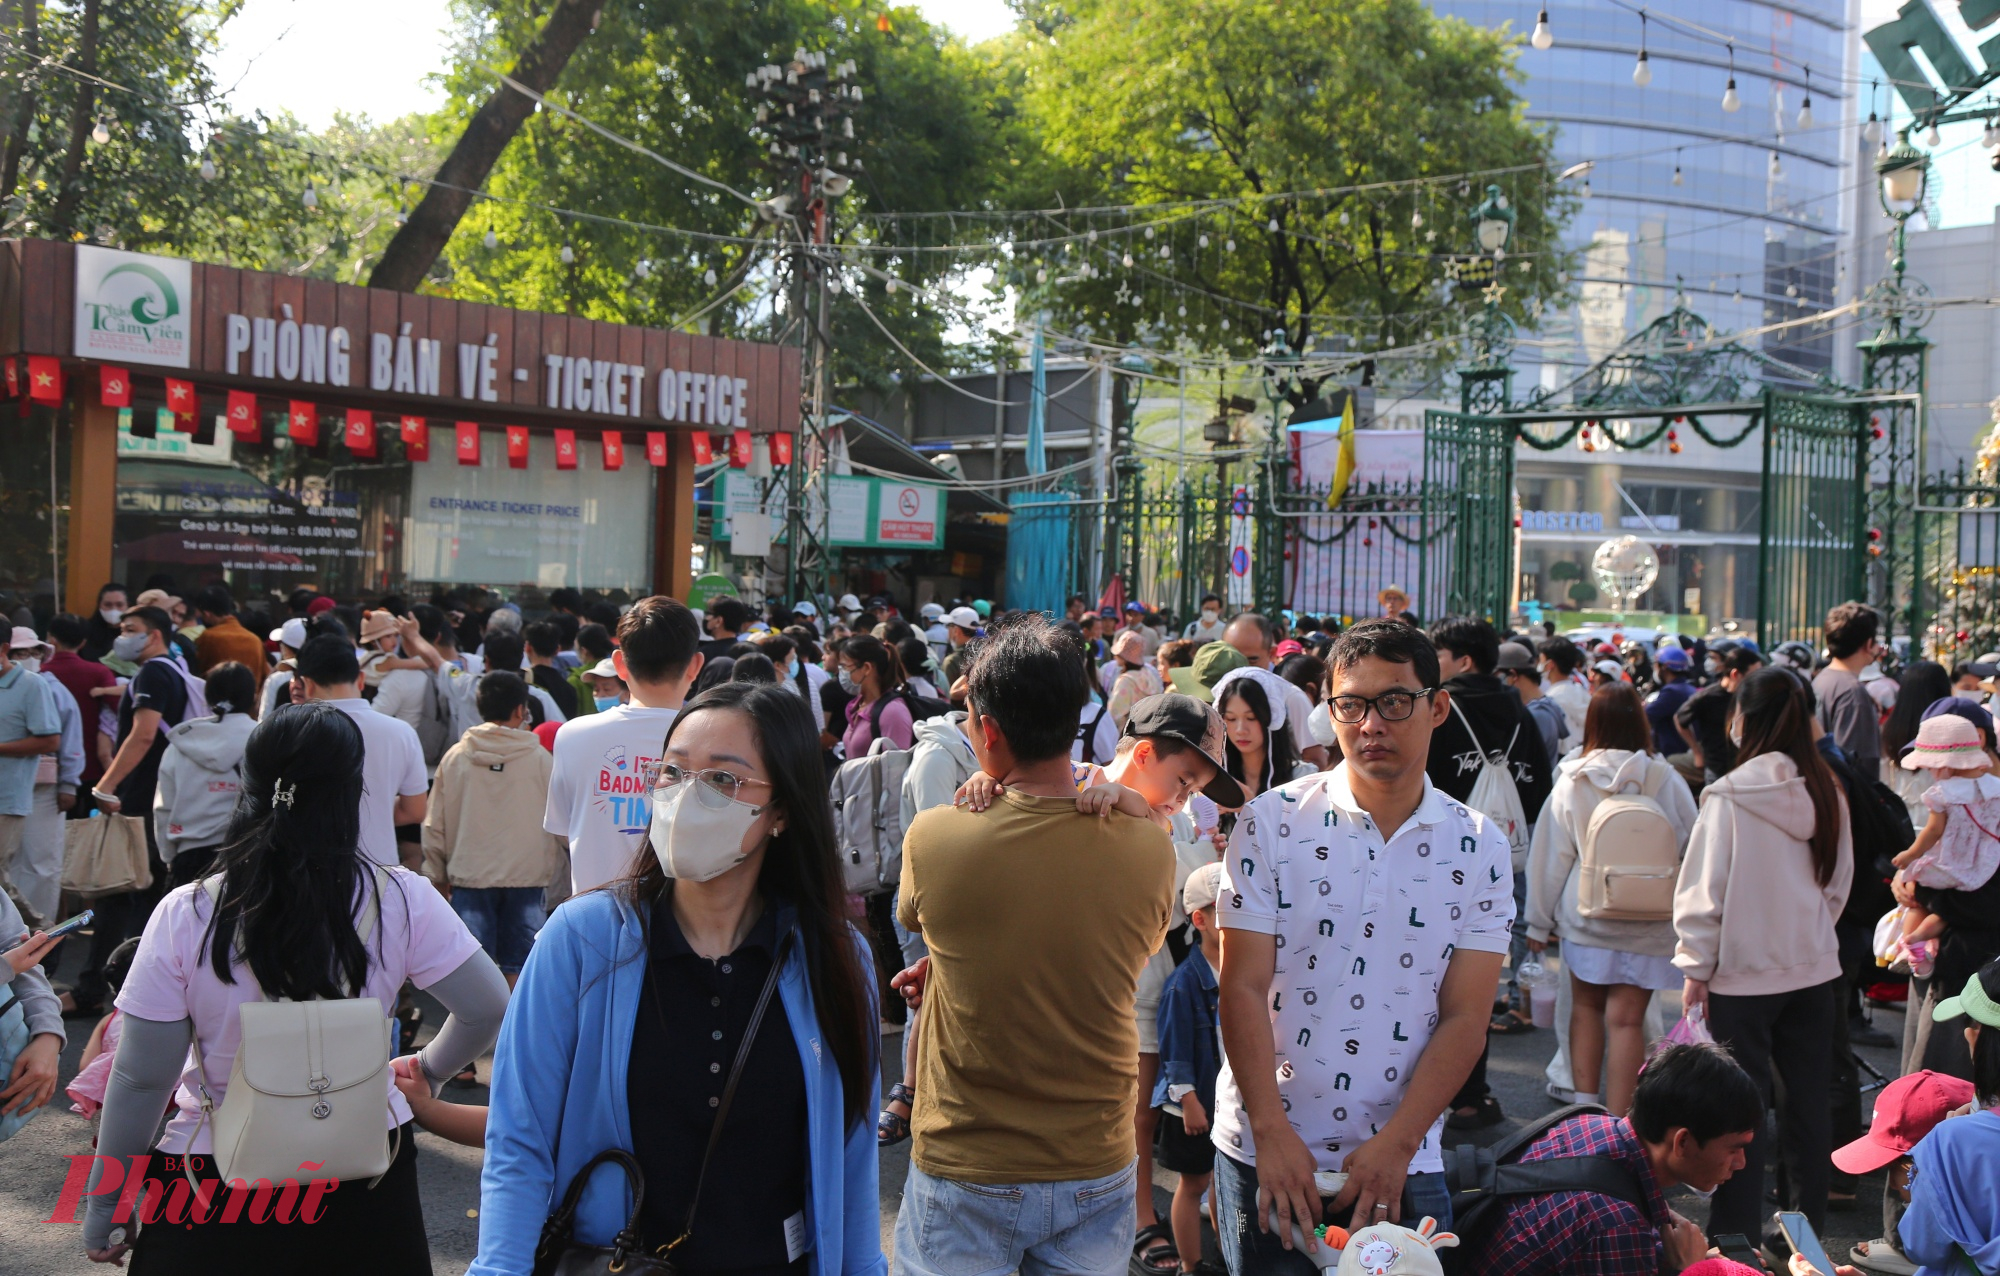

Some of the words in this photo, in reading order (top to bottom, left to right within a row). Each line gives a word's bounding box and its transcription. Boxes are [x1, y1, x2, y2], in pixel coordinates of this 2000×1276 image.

[226, 303, 350, 387] PHÒNG
[371, 322, 441, 396] BÁN
[459, 332, 498, 402] VÉ
[545, 353, 645, 417] TICKET
[658, 368, 748, 428] OFFICE
[429, 497, 497, 513] ENTRANCE
[501, 502, 542, 515] TICKET
[546, 505, 581, 517] PRICE
